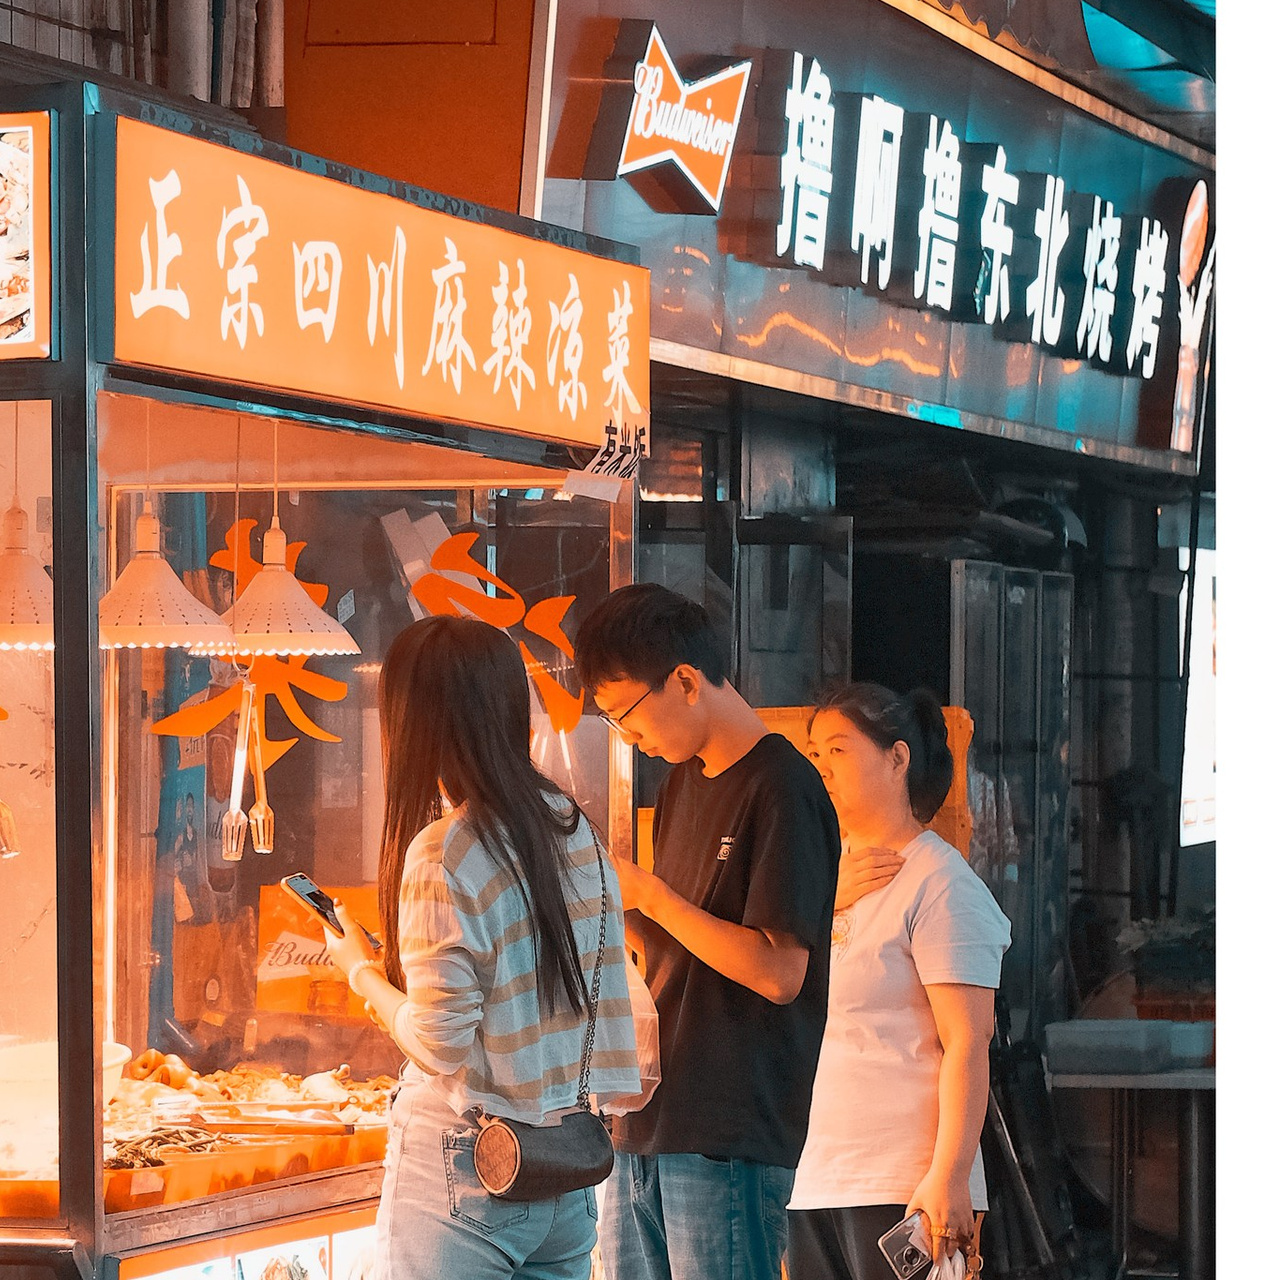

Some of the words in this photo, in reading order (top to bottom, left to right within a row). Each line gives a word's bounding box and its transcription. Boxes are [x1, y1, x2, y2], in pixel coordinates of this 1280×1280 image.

[634, 61, 736, 158] Budweiser
[776, 51, 1170, 380] 撸啊撸东北烧烤
[129, 167, 642, 420] 正宗四川麻辣凉菜
